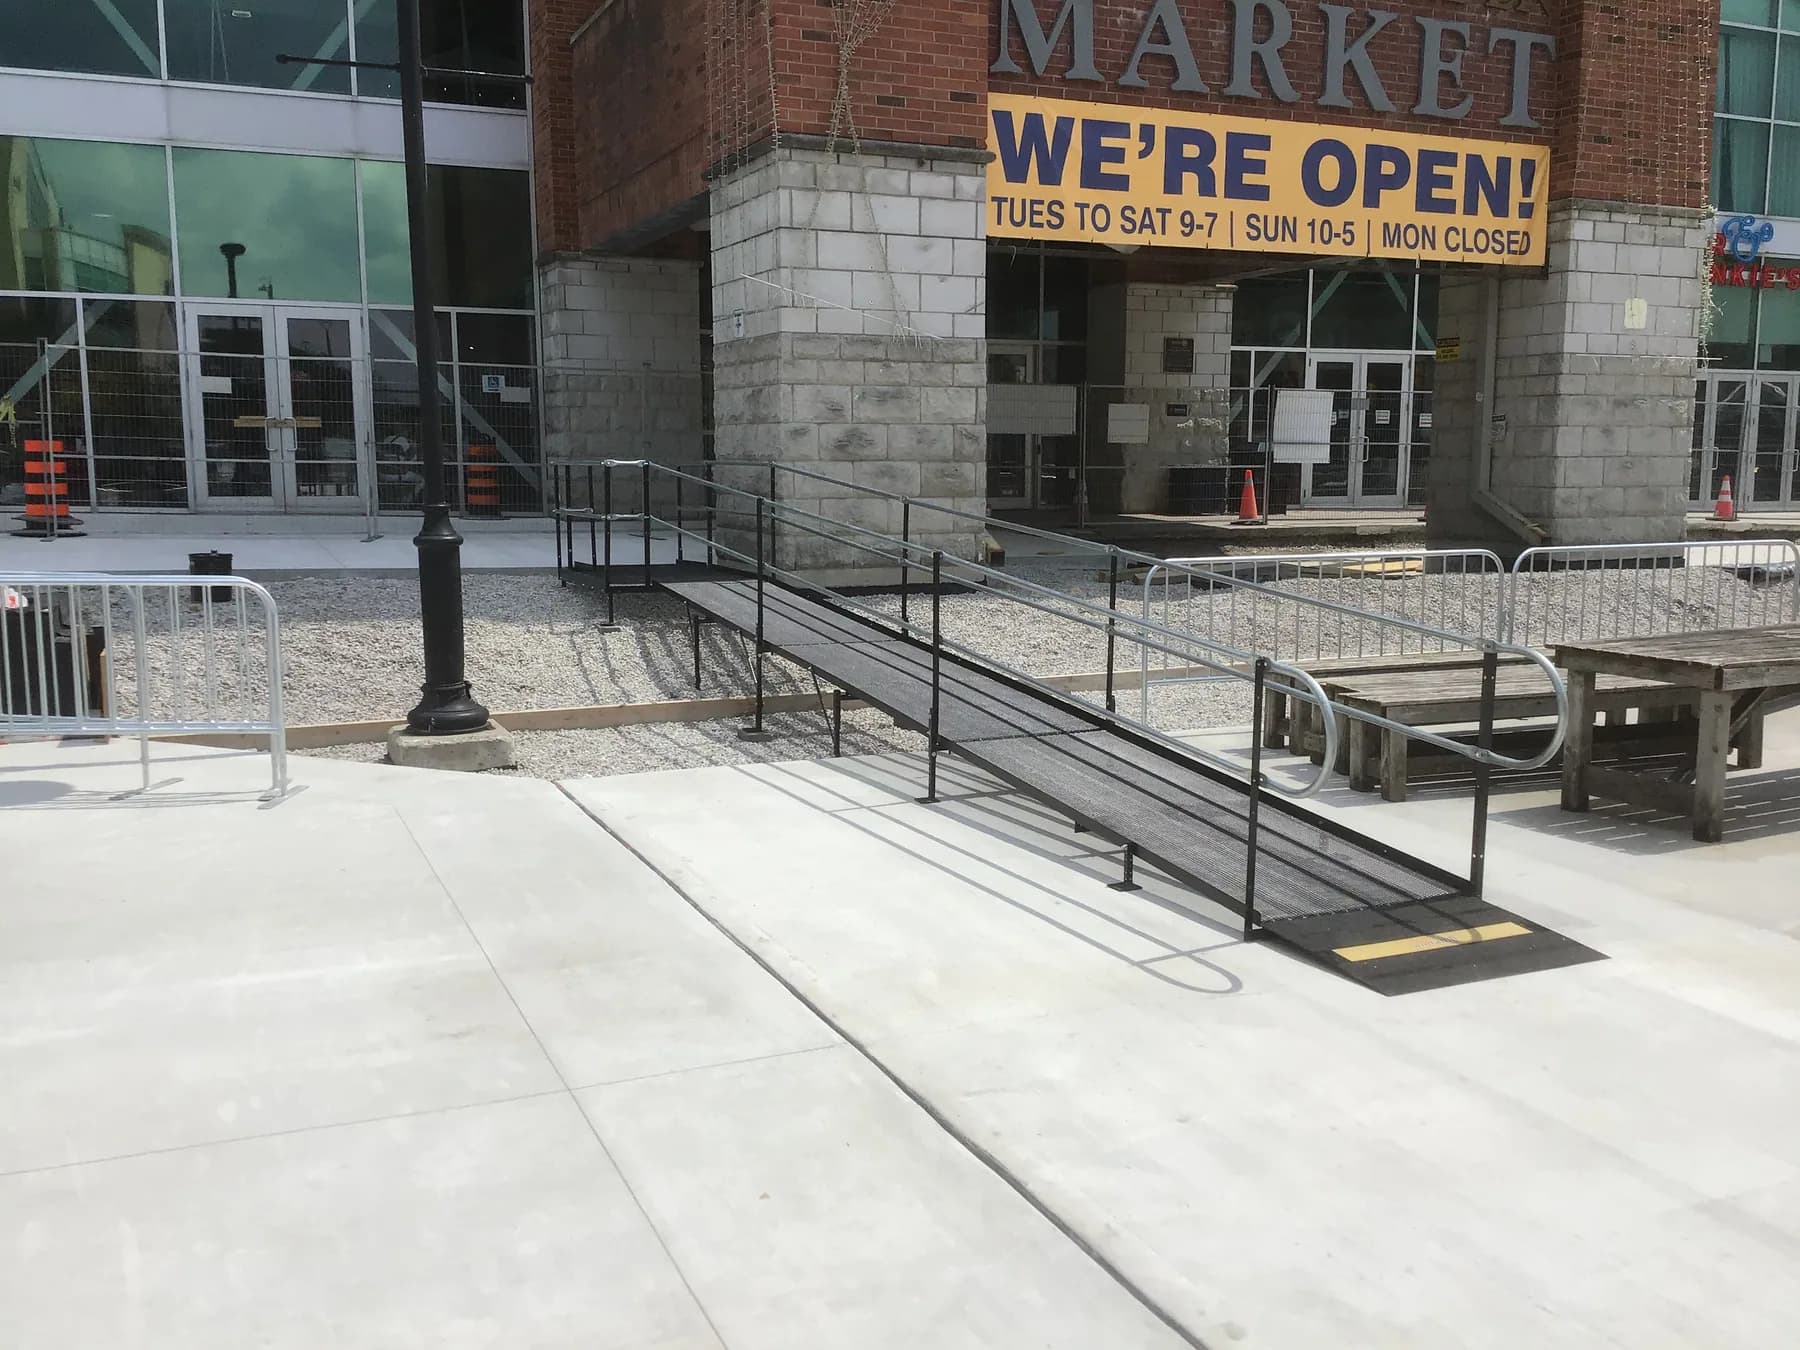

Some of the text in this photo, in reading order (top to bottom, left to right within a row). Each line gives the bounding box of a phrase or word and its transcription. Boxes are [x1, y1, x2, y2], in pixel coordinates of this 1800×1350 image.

[990, 0, 1555, 128] MARKET
[992, 110, 1536, 219] WE'RE OPEN!
[991, 196, 1531, 255] TUES TO SAT 9-7 SUN 10-5 MON CLOSED
